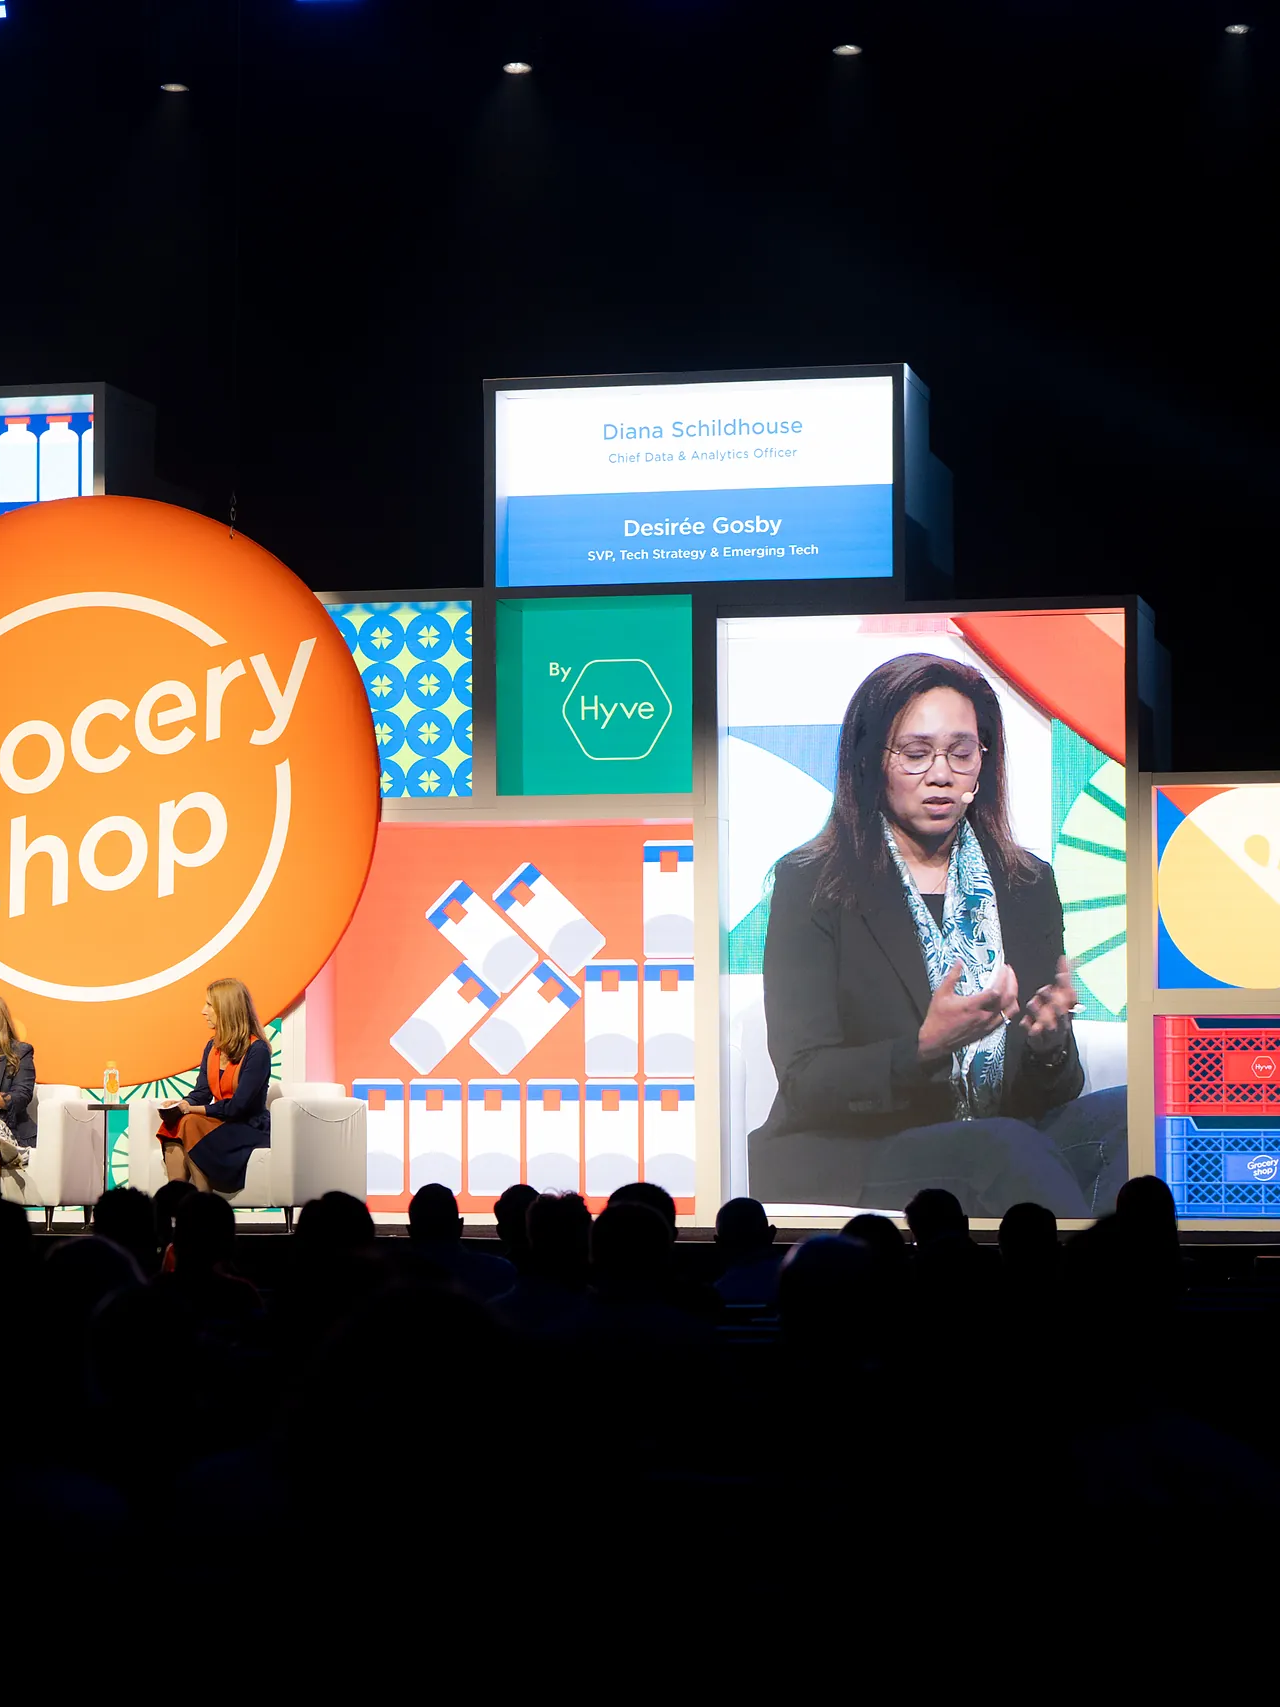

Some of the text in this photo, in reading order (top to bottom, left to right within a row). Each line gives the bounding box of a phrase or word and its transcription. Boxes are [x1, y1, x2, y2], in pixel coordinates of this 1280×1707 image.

[603, 418, 803, 441] Diana Schildhouse
[608, 447, 797, 464] Chief Data & Analytics Officer
[624, 515, 782, 538] Desirée Gosby
[587, 544, 819, 563] SVP, Tech Strategy & Emerging Tech
[548, 661, 572, 683] By
[580, 694, 655, 730] Hyve
[1255, 1064, 1273, 1072] Hyve
[1247, 1159, 1279, 1170] Grocery
[1252, 1168, 1273, 1177] shop
